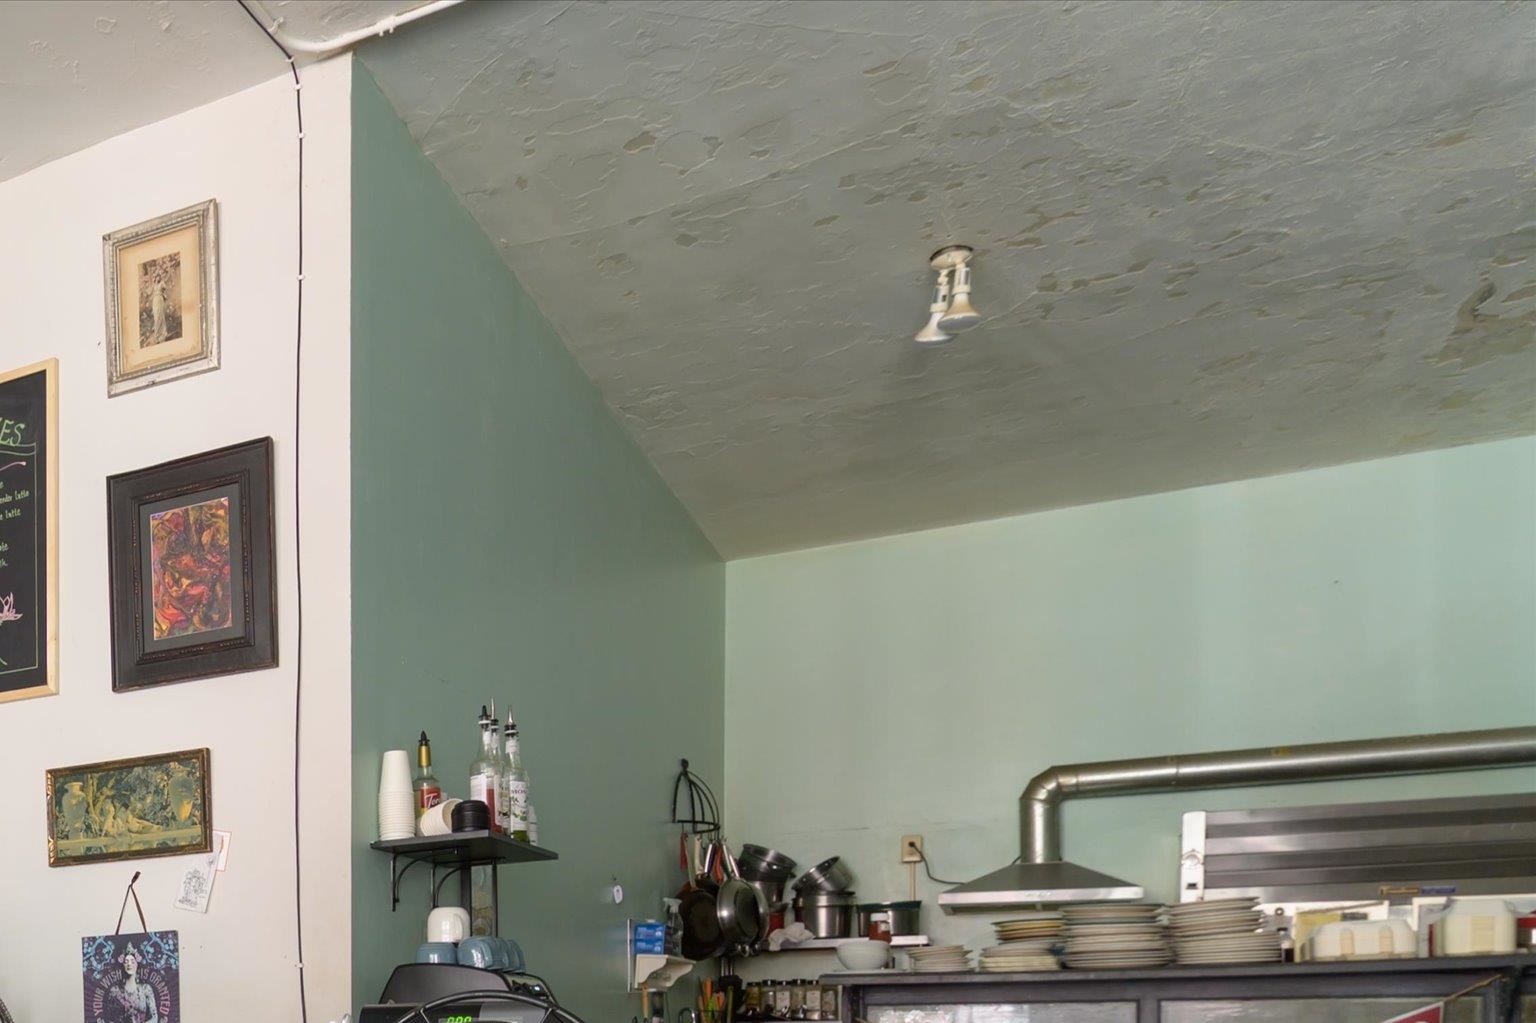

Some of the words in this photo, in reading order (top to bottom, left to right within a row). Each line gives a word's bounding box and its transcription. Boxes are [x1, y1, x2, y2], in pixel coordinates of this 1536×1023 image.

[14, 489, 30, 500] latte
[5, 507, 22, 519] latte
[92, 986, 105, 1017] YOUR
[99, 968, 123, 990] WISH
[140, 968, 150, 981] IS
[149, 971, 171, 1016] GRANTED
